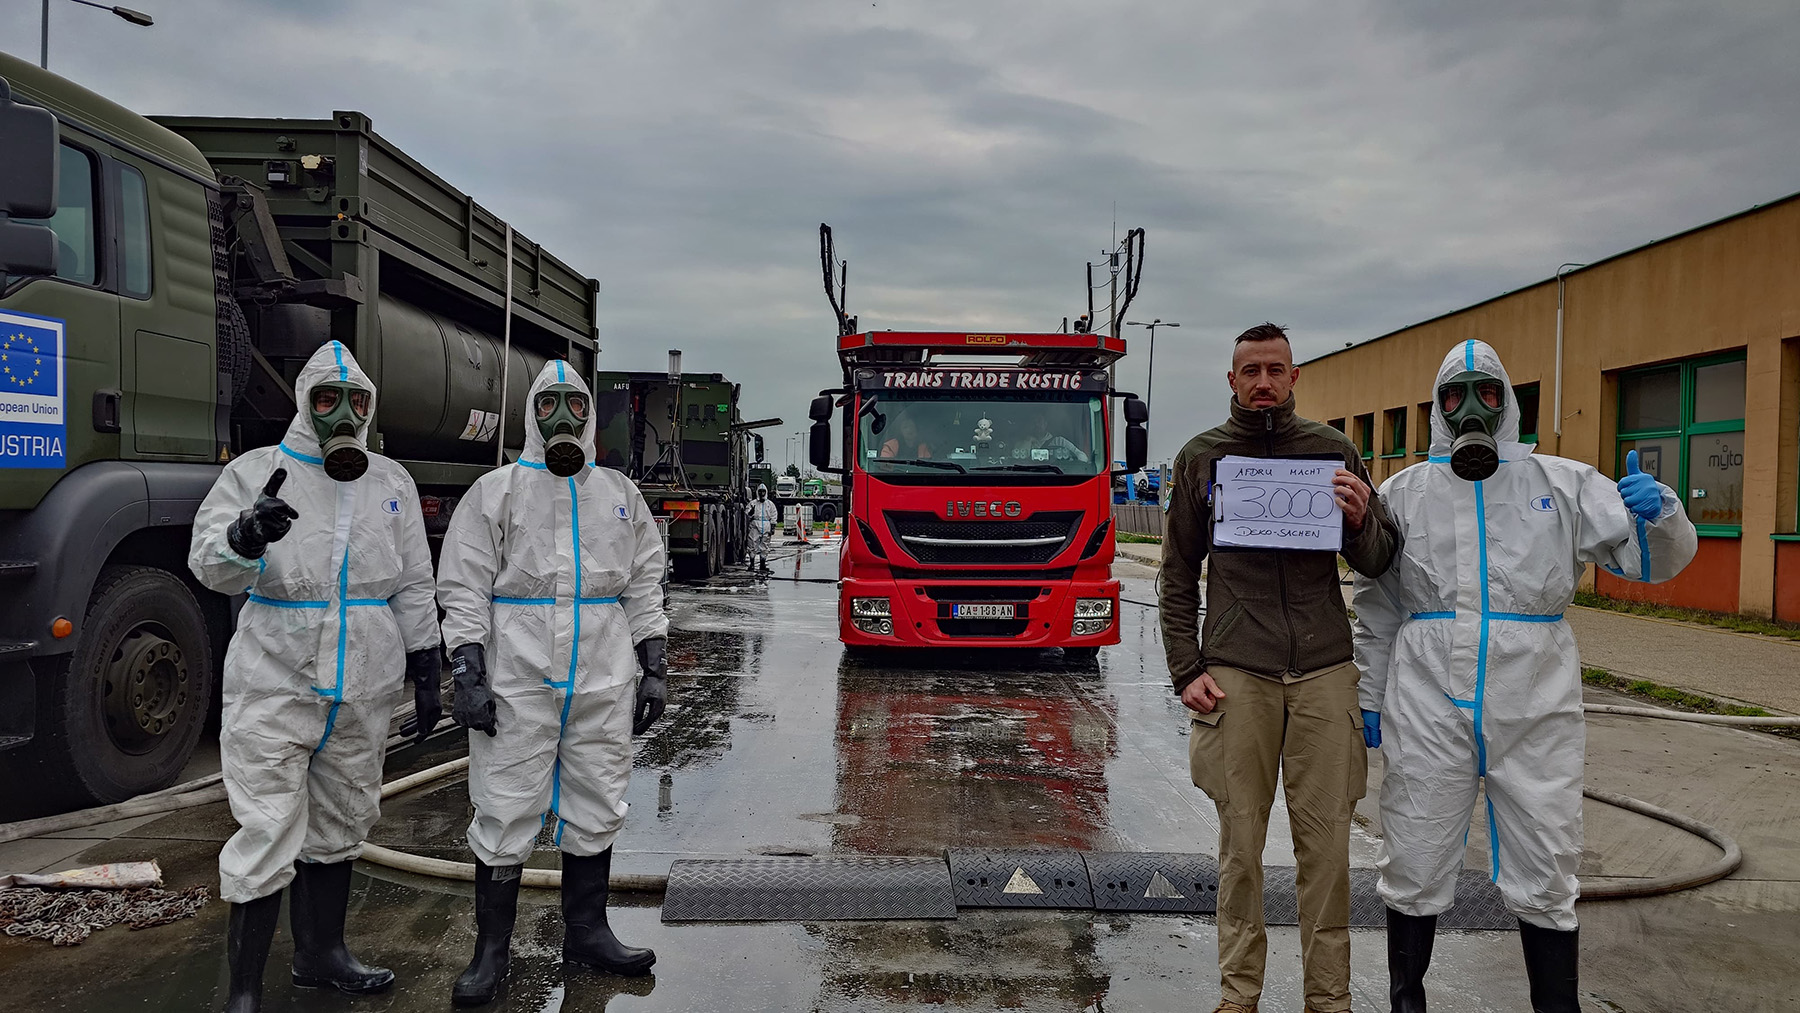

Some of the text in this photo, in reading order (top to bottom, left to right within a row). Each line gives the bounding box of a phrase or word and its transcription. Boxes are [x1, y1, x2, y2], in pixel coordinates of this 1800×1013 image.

[967, 335, 1005, 343] ROLFO
[884, 371, 1082, 390] TRANS TRADE KOSTIĆ
[0, 403, 59, 415] opean Union
[1645, 459, 1656, 471] WC
[1708, 450, 1743, 470] myto
[1235, 467, 1325, 478] AFDRU MACHT
[1233, 486, 1334, 519] 3.000
[947, 501, 1022, 517] IVECO
[959, 605, 972, 616] CA
